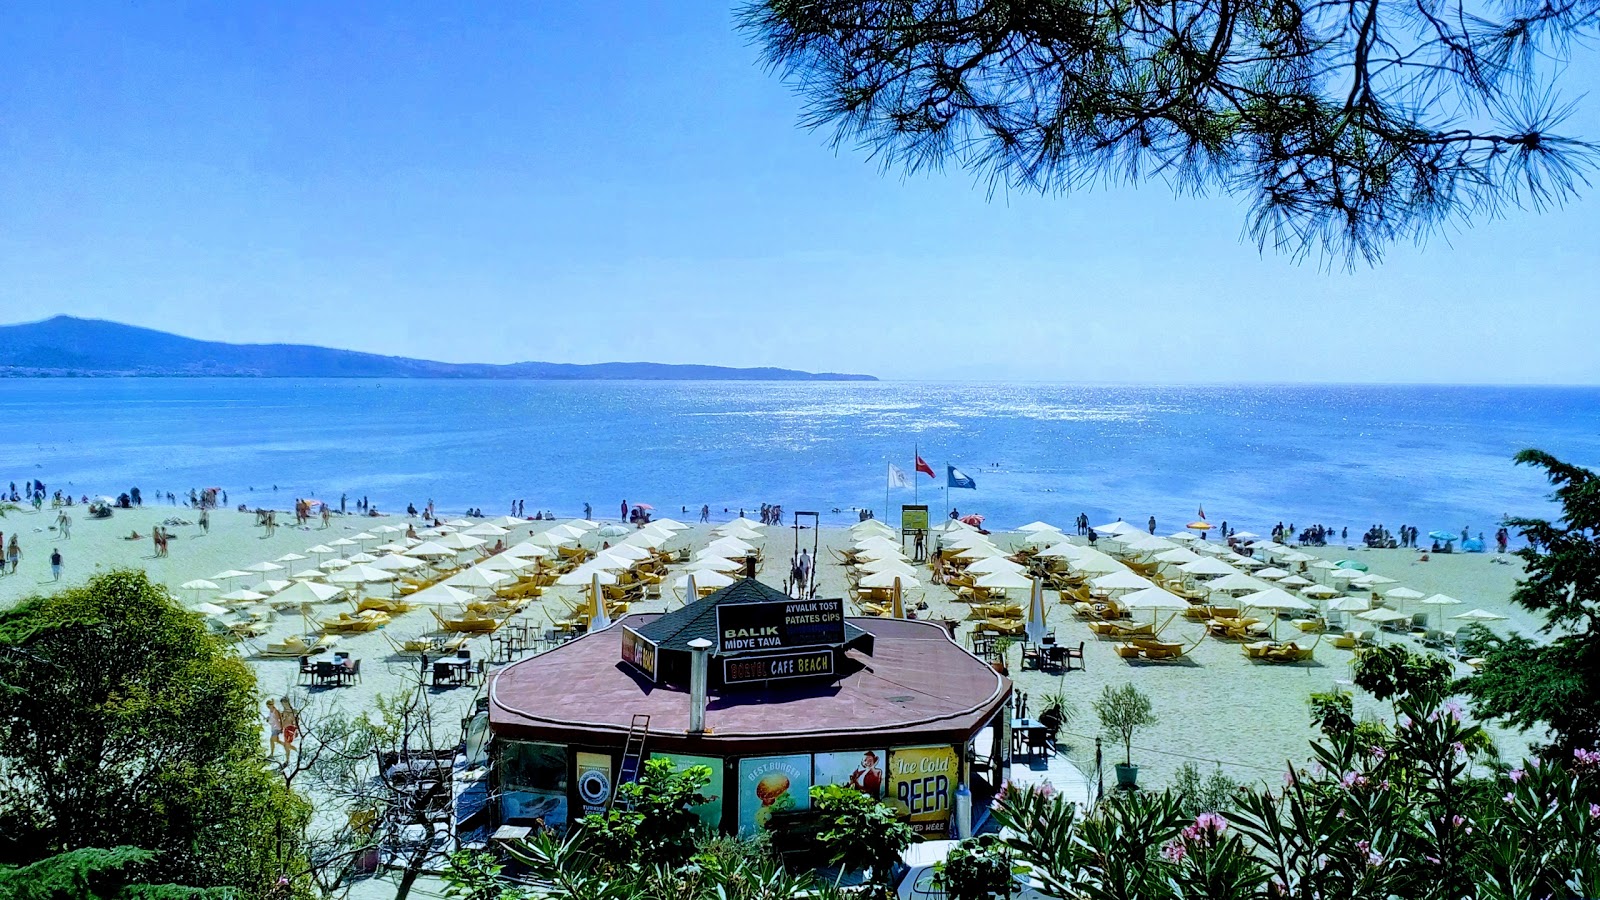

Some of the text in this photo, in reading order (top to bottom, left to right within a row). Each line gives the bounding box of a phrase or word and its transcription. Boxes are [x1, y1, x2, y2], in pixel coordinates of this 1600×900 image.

[786, 602, 838, 613] AYVALIK TOST
[785, 614, 820, 625] PATATES
[725, 626, 779, 638] BALIK
[725, 638, 755, 650] MİDYE
[758, 637, 781, 647] TAVA
[771, 660, 794, 675] CAFE
[798, 655, 828, 673] BEACH
[748, 762, 801, 781] BEST BURGER
[897, 757, 949, 774] Ice Cold
[897, 775, 950, 816] BEER
[925, 822, 945, 831] HERE
